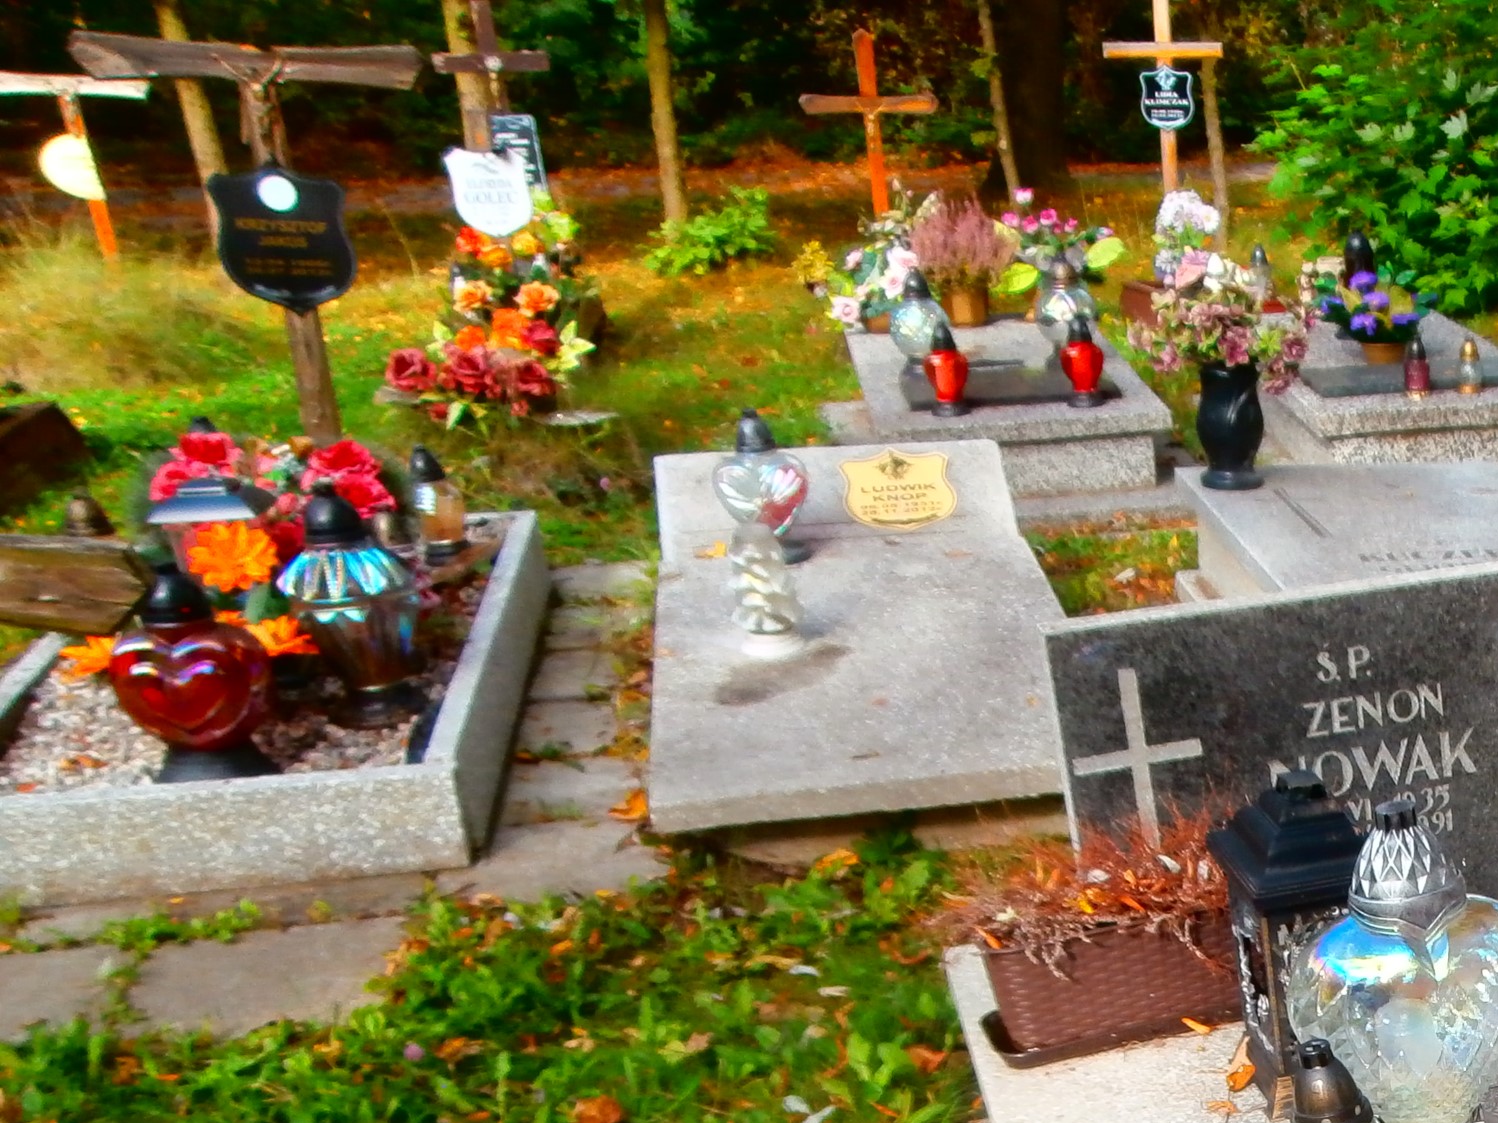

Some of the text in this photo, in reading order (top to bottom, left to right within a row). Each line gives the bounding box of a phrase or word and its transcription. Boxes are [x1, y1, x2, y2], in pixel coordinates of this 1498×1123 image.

[861, 483, 937, 494] LUDWIK
[873, 492, 927, 502] KNOP
[1303, 682, 1444, 738] ZENON
